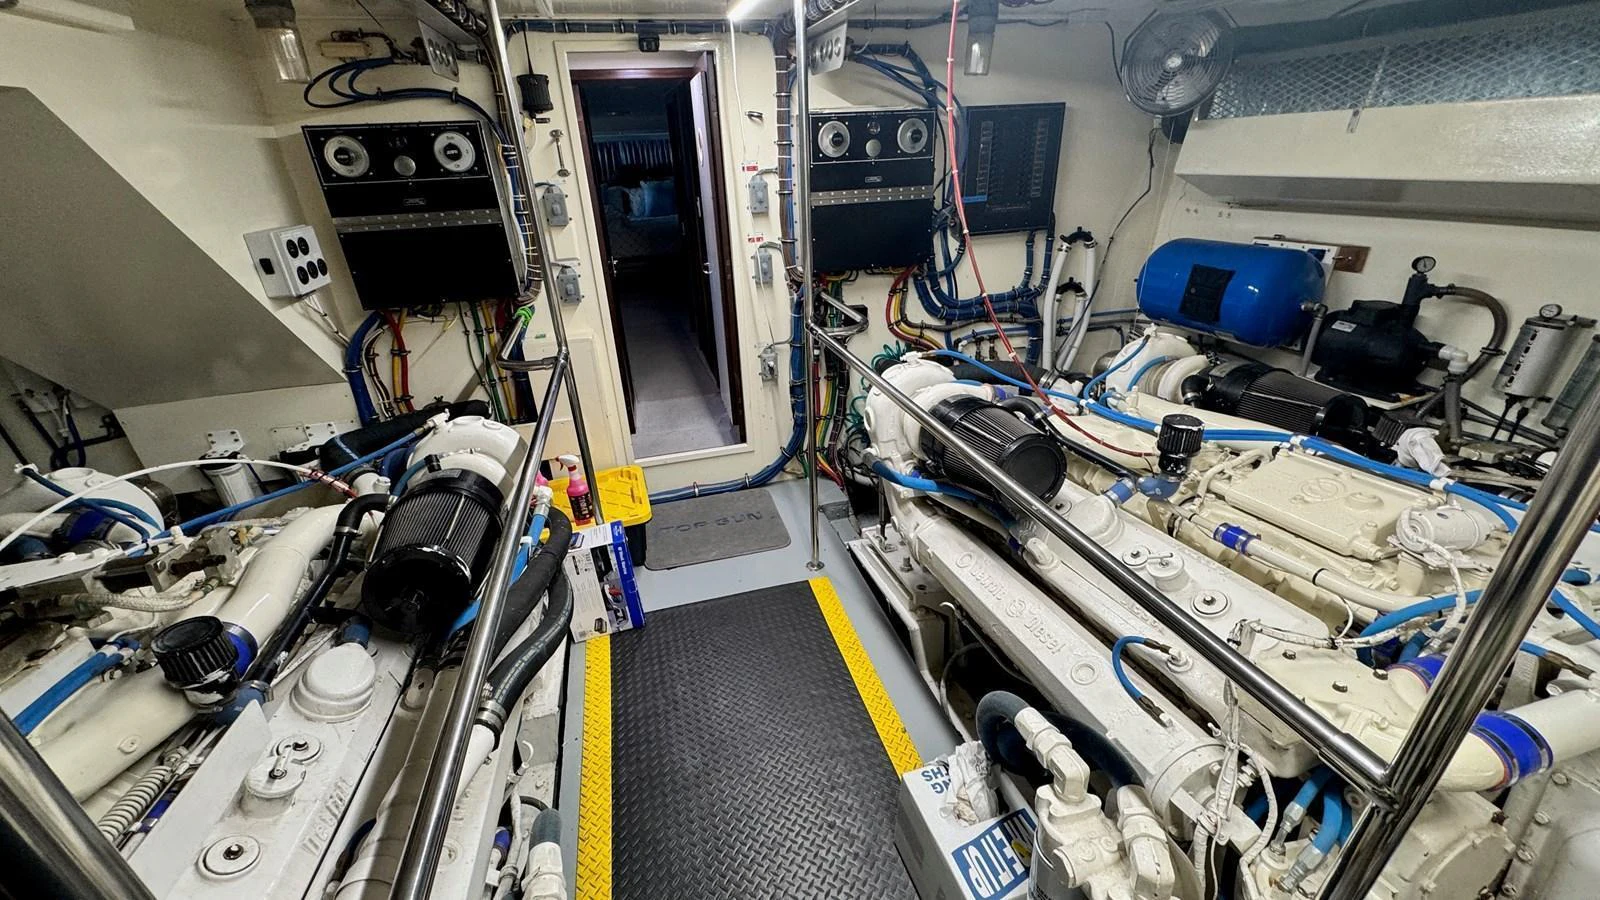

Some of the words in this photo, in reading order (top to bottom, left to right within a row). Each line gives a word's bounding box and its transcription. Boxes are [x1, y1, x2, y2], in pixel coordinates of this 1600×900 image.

[659, 520, 708, 533] TOP
[714, 511, 763, 526] GUN
[1023, 614, 1066, 655] Diesel
